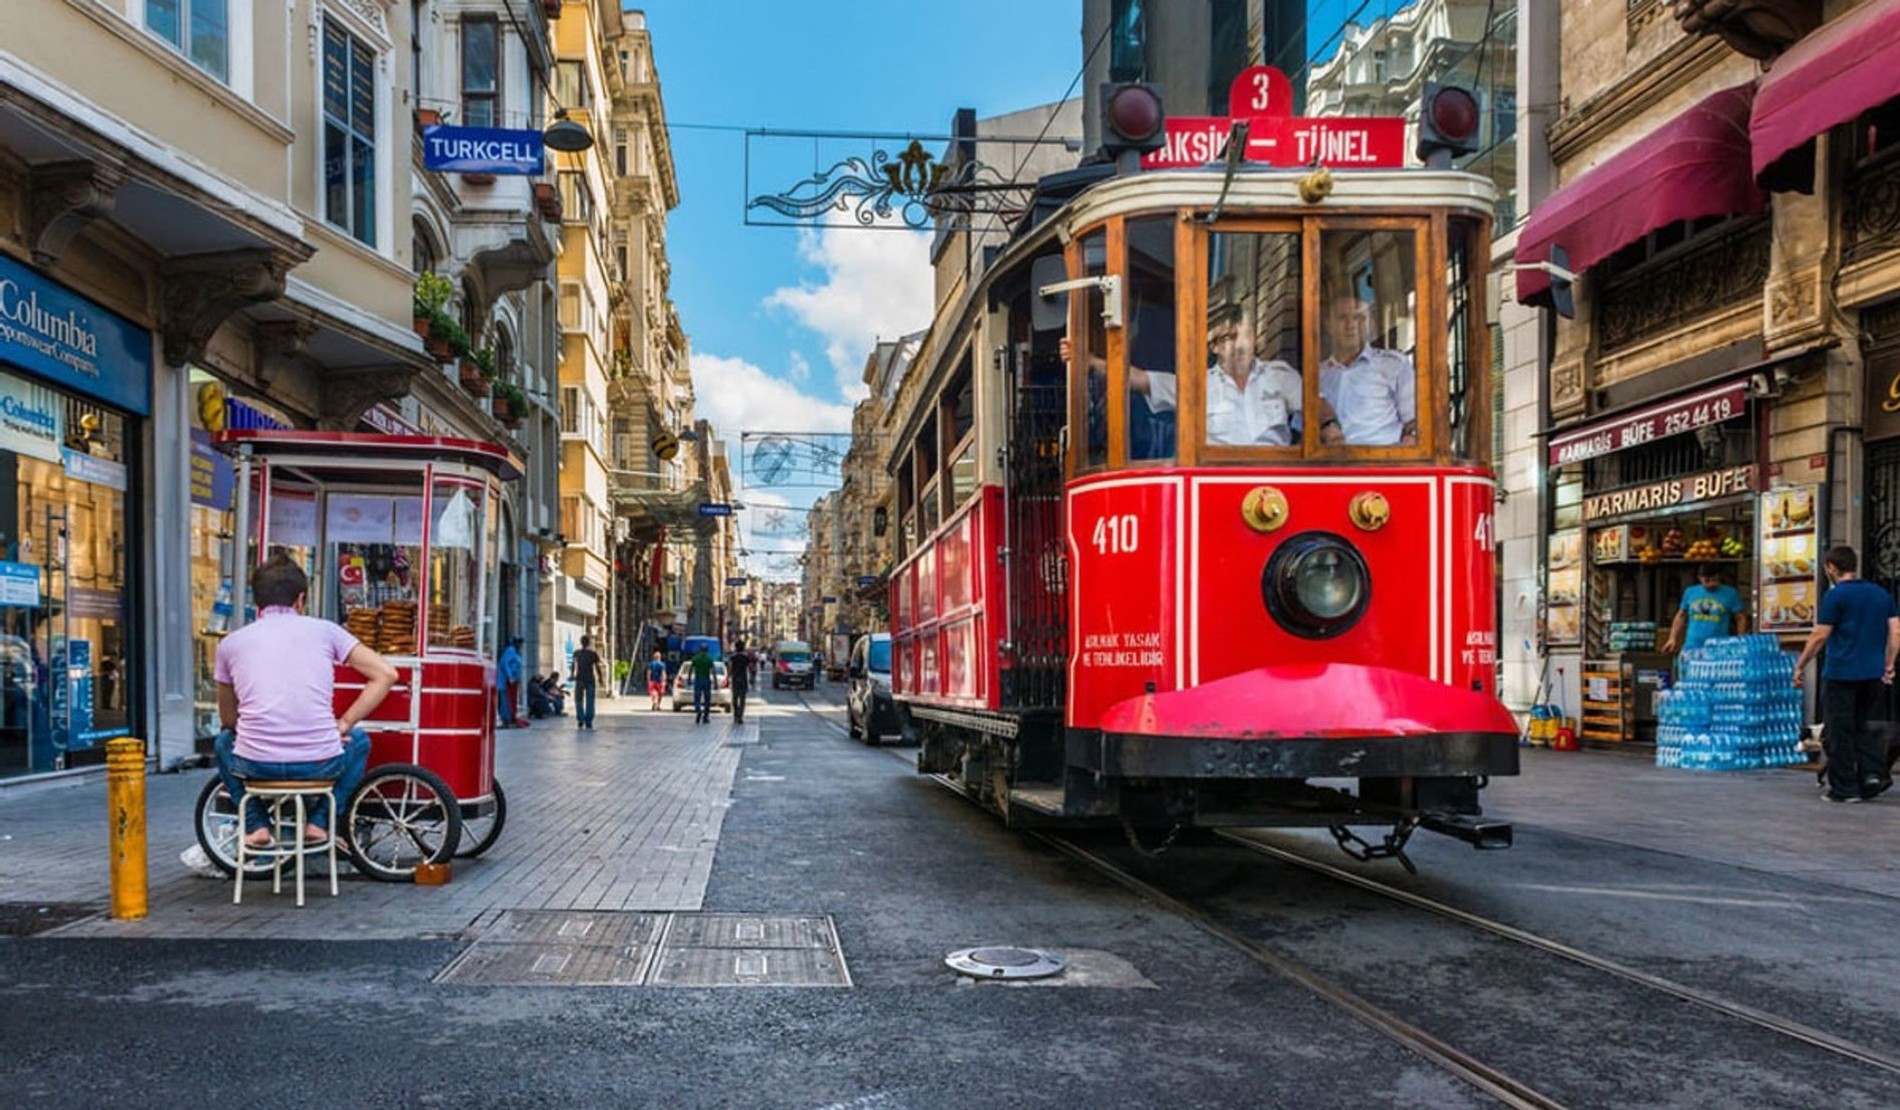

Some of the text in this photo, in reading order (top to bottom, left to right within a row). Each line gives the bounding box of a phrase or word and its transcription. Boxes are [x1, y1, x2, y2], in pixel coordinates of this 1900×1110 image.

[1252, 73, 1270, 110] 3
[430, 137, 538, 163] TURKCELL
[1294, 125, 1377, 162] TÜNEL
[0, 279, 96, 357] Columbia
[1664, 411, 1690, 435] 252
[1692, 403, 1709, 424] 44
[1712, 398, 1731, 419] 19
[1092, 514, 1139, 555] 410
[1123, 632, 1160, 648] YASAK
